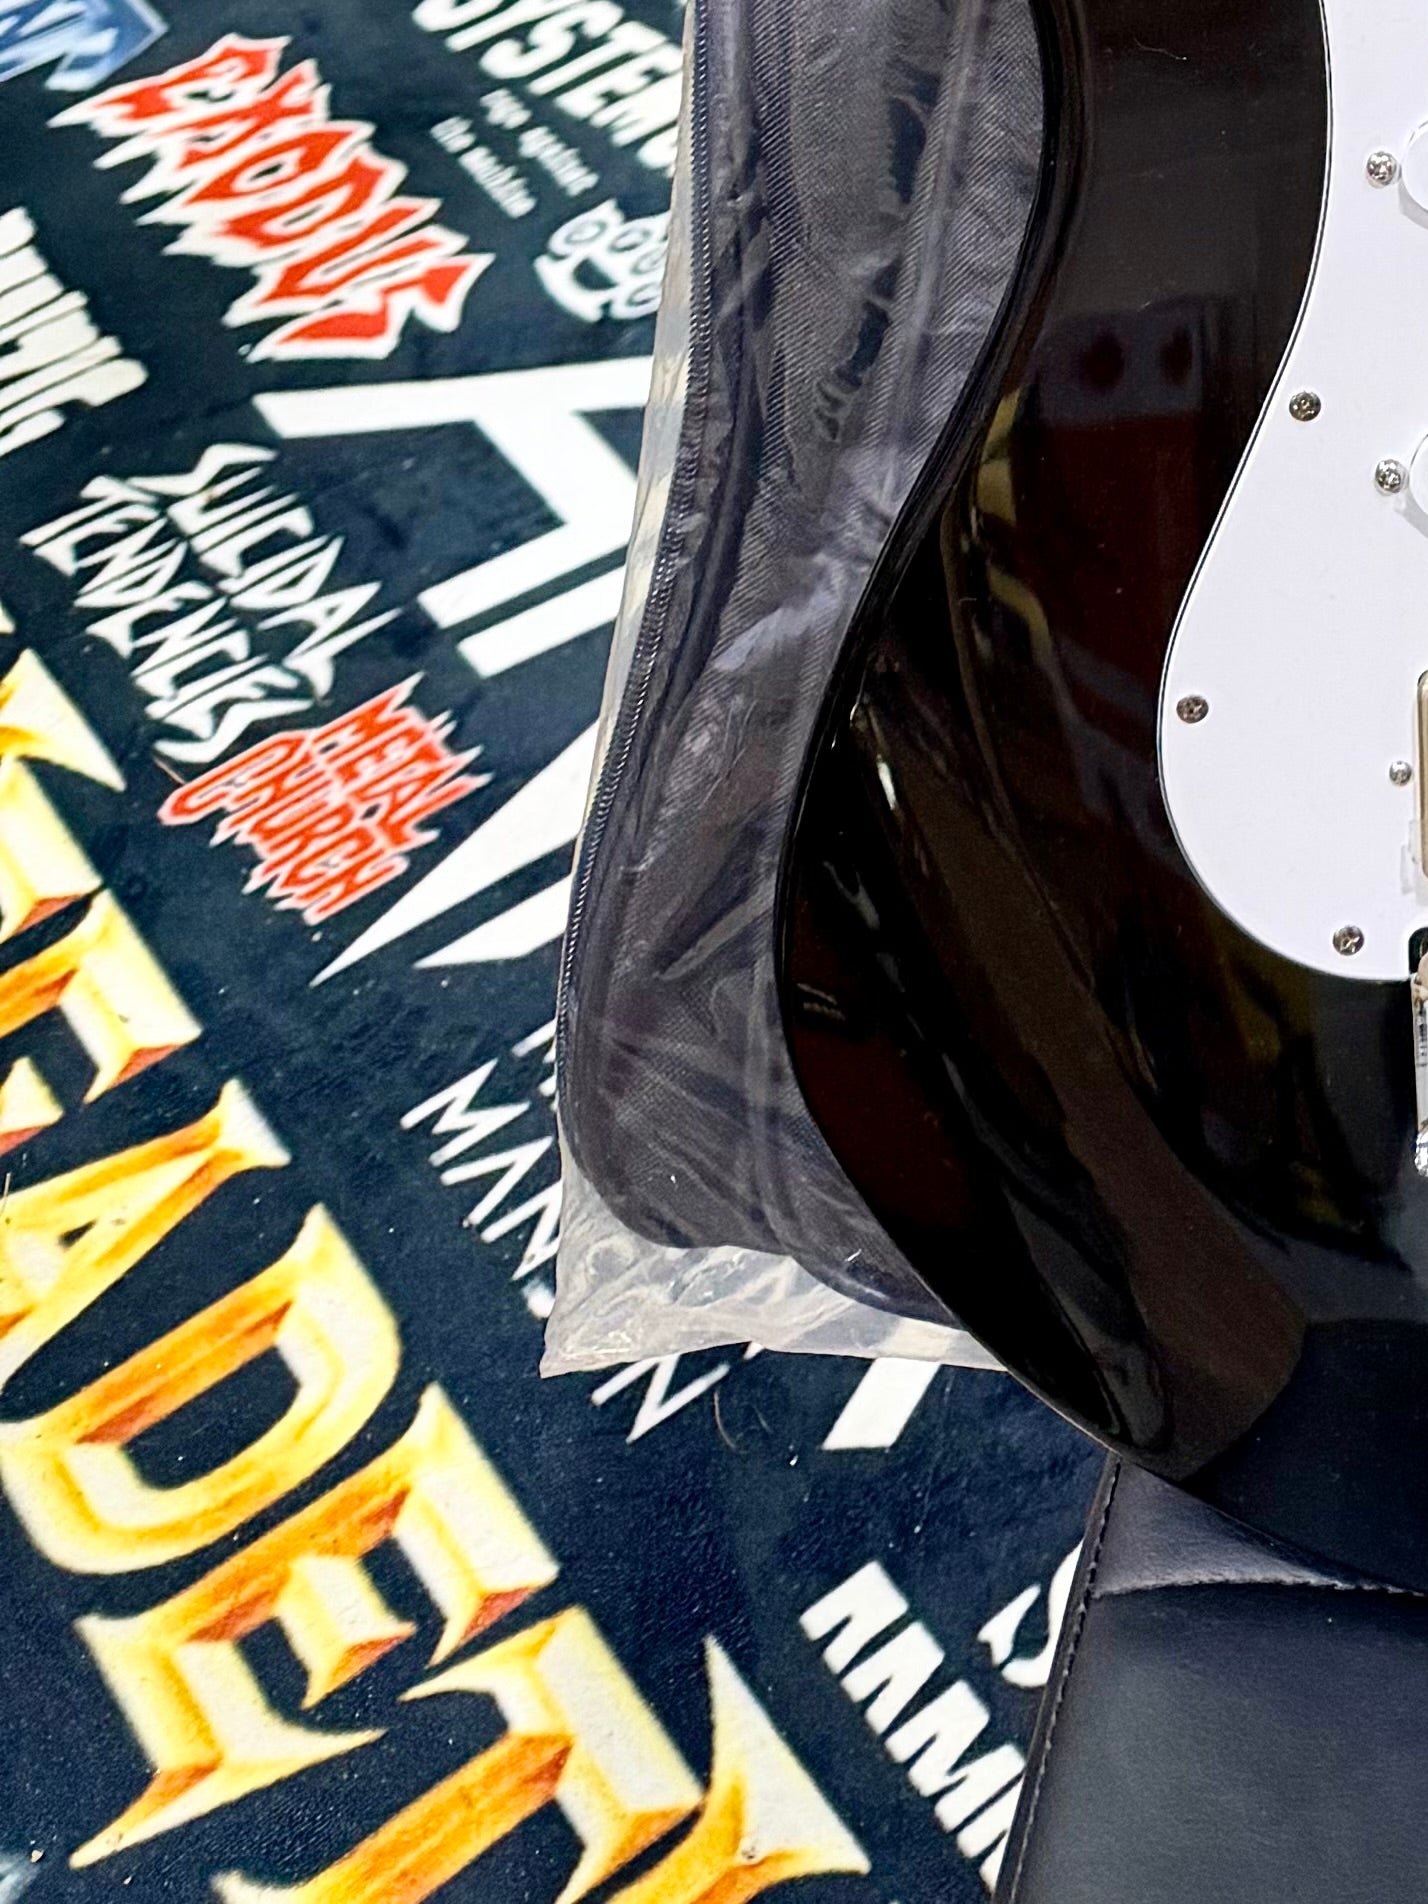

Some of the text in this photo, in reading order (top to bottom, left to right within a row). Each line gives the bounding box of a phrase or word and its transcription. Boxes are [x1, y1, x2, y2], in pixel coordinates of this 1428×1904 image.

[47, 32, 496, 363] EXODUS
[20, 475, 314, 765] TENDENCIES
[128, 443, 400, 704] SUICIDAL
[158, 723, 409, 925] CHURCH
[305, 670, 495, 854] METAL
